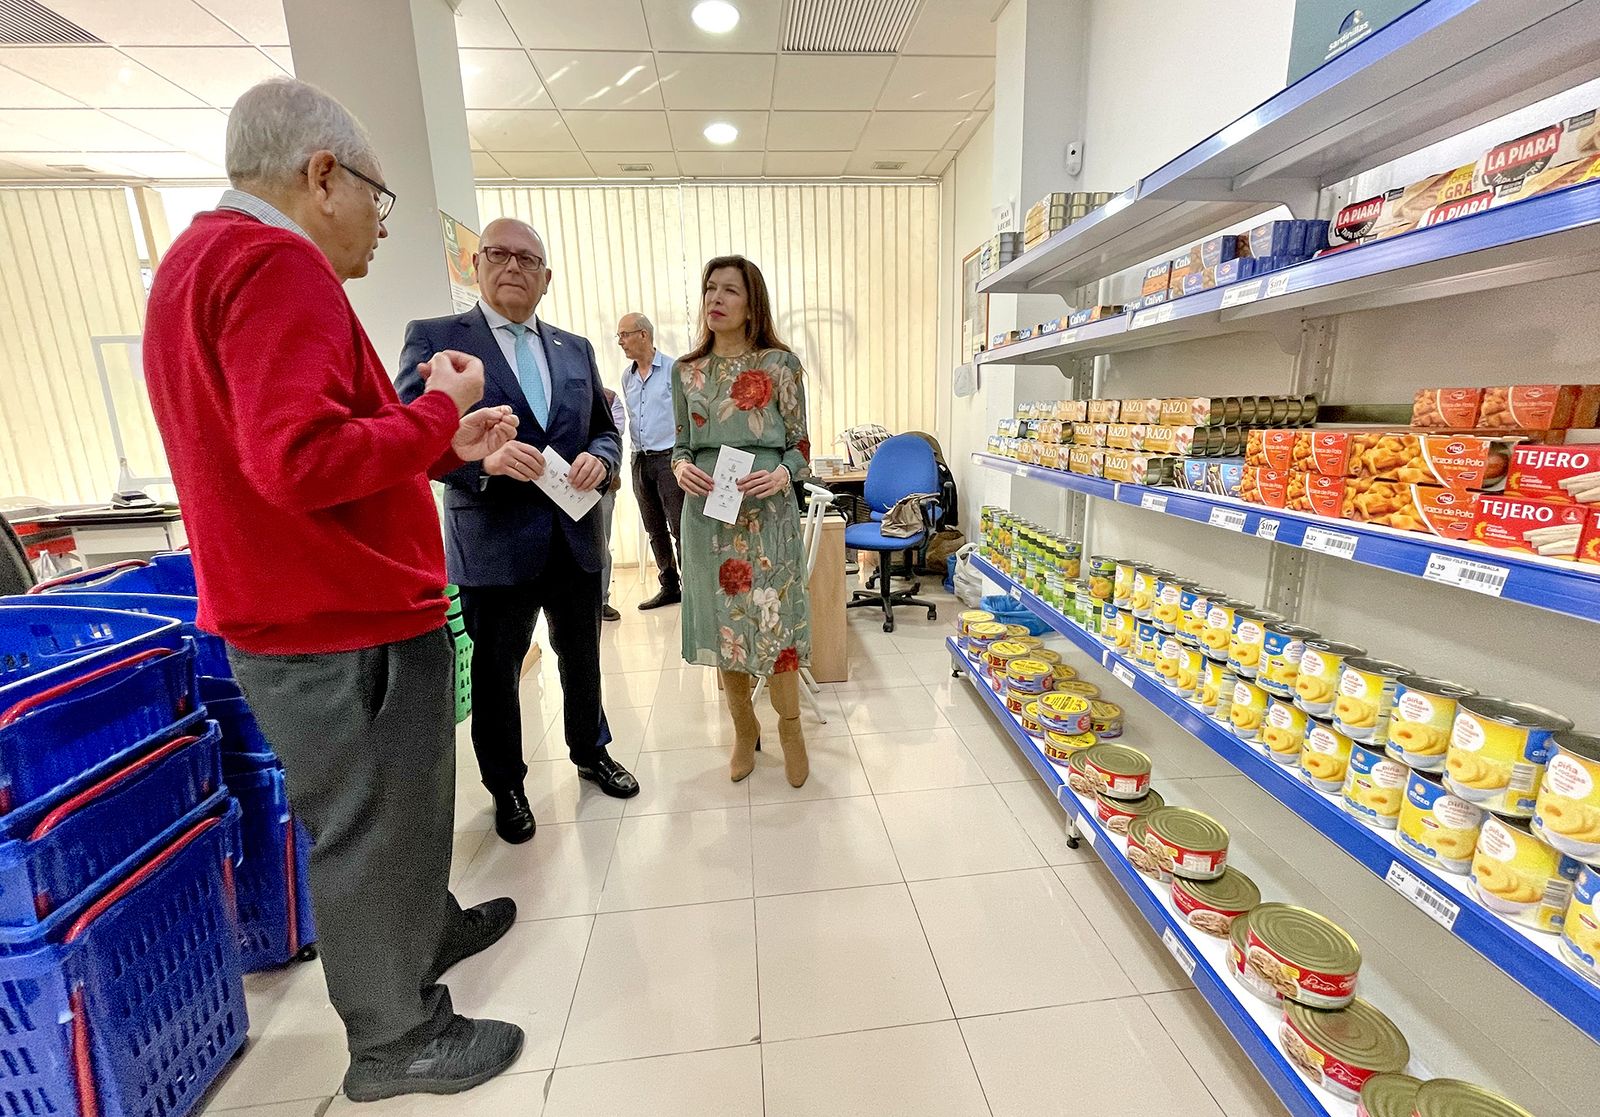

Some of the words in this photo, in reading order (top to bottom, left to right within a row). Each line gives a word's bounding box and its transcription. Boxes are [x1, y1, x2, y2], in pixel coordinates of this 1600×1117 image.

[1487, 151, 1506, 172] LA
[1507, 133, 1556, 164] PIARA
[1338, 211, 1350, 226] LA
[1350, 201, 1381, 222] PIARA
[1428, 209, 1445, 226] LA
[1446, 198, 1488, 220] PIARA
[1148, 265, 1167, 278] Calvo
[1145, 293, 1163, 305] Calvo
[1070, 314, 1086, 325] Calvo
[1042, 323, 1056, 333] Calvo
[1122, 402, 1143, 413] RAZO
[1162, 402, 1187, 413] RAZO
[1075, 426, 1092, 435] RAZO
[1108, 427, 1127, 437] RAZO
[1146, 428, 1171, 440] RAZO
[1071, 452, 1088, 463] RAZO
[1106, 457, 1127, 470] RAZO
[1453, 457, 1464, 466] de
[1465, 458, 1484, 467] Pota
[1515, 449, 1589, 469] TEJERO
[1443, 507, 1454, 515] de
[1455, 508, 1475, 519] Pota
[1480, 499, 1553, 522] TEJERO
[1261, 522, 1273, 531] sin
[1430, 562, 1446, 571] 0.39
[1452, 558, 1469, 566] FILETE
[1476, 563, 1499, 572] CABALLA
[1406, 697, 1424, 706] piña
[1382, 765, 1400, 773] piña
[1557, 761, 1579, 774] piña
[1409, 789, 1430, 806] alteza
[1447, 800, 1470, 810] piña
[1488, 825, 1505, 840] piña
[1391, 869, 1405, 883] 0.54
